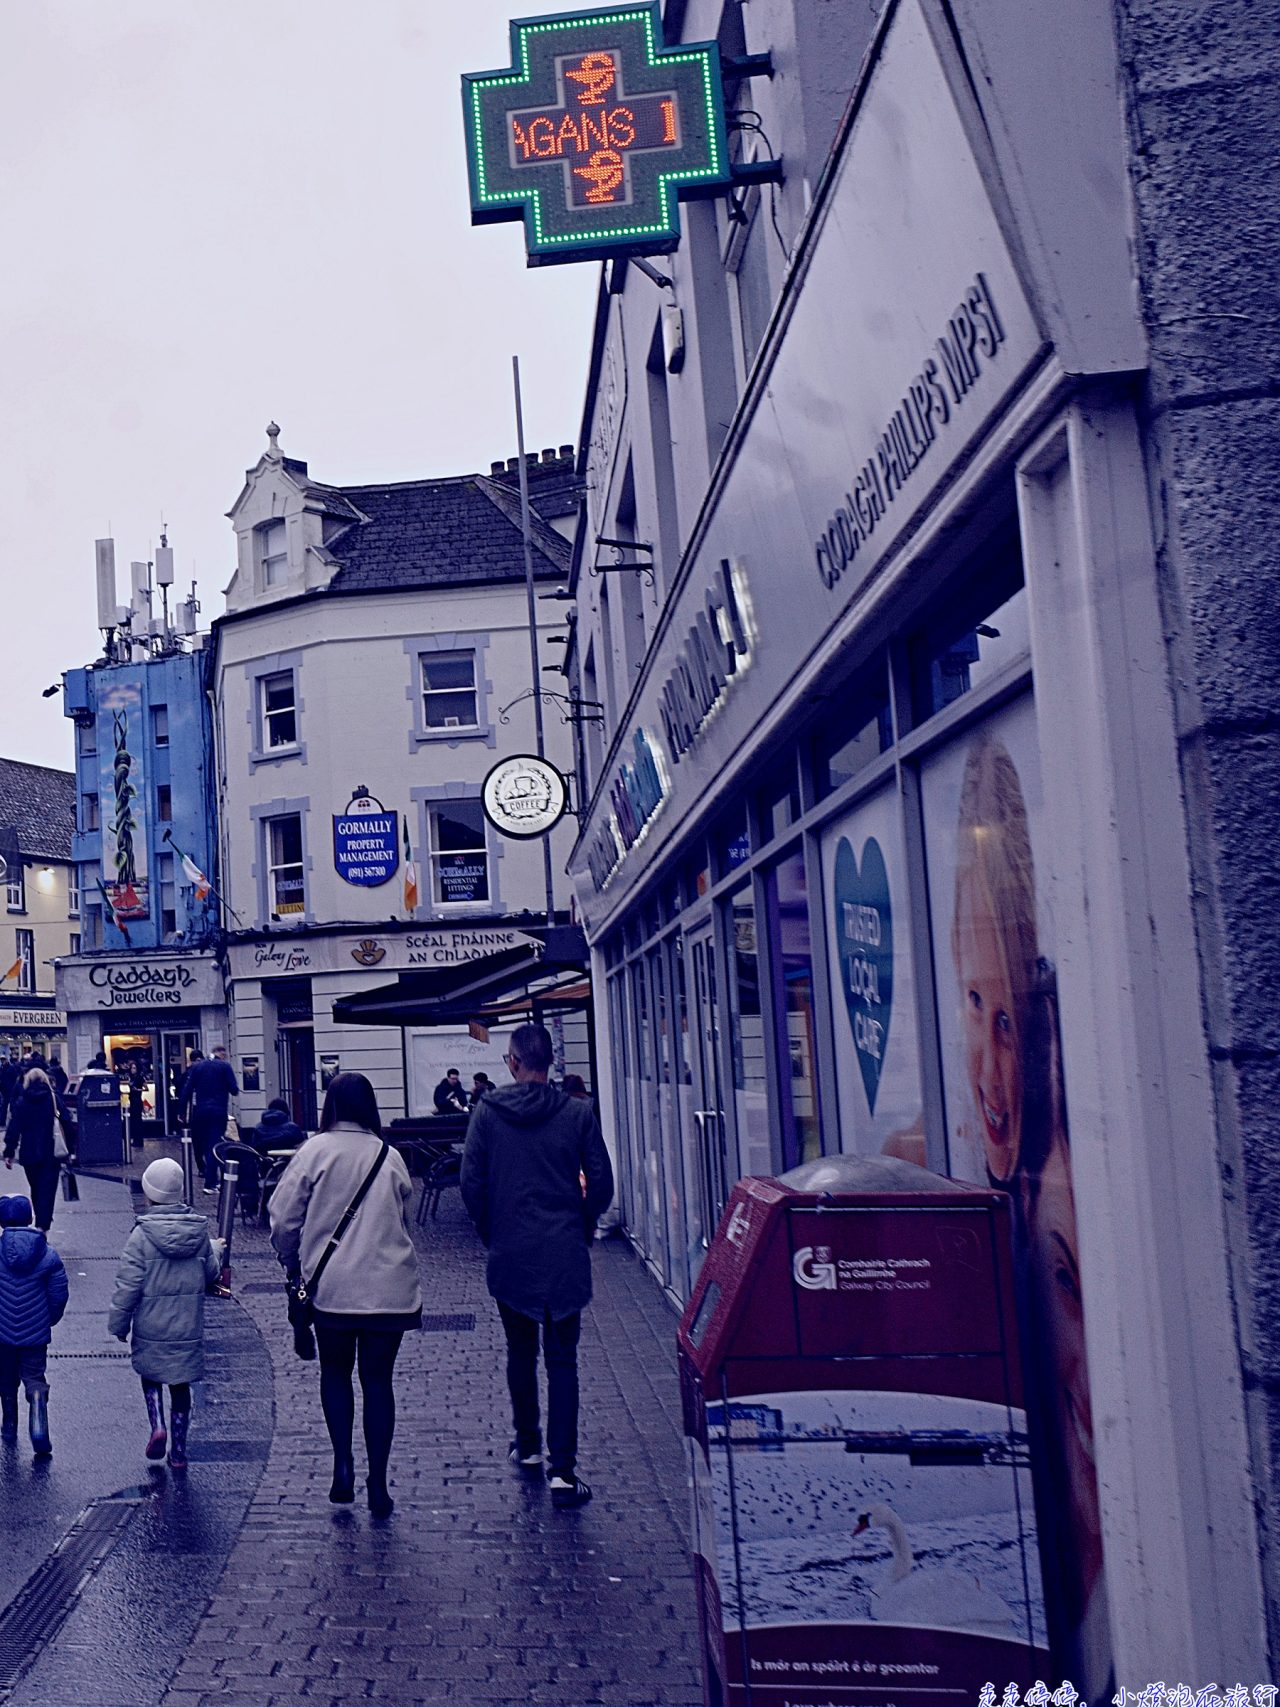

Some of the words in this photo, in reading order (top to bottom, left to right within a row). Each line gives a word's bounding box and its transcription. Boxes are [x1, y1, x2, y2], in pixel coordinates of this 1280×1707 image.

[876, 358, 950, 502] PHILLIPS
[935, 272, 1005, 404] MPSI
[509, 800, 541, 811] COFFEE
[337, 820, 392, 835] GORMALLY
[347, 839, 384, 850] PROPERTY
[339, 850, 394, 862] MANAGEMENT
[842, 901, 882, 947] TRUSTED
[89, 963, 197, 992] Claddagh
[848, 953, 882, 1005] LOCAL
[98, 988, 182, 1007] Jewellers
[13, 1011, 62, 1025] EVERGREEN
[838, 1259, 887, 1269] Comhairle
[887, 1258, 931, 1268] Cathrach
[852, 1269, 897, 1278] Gaillimhe
[839, 1281, 873, 1292] Galway
[875, 1280, 894, 1290] City
[895, 1280, 931, 1290] Council
[751, 1658, 763, 1671] Is
[763, 1659, 790, 1672] mór
[792, 1661, 810, 1672] an
[879, 1662, 940, 1676] gceantar
